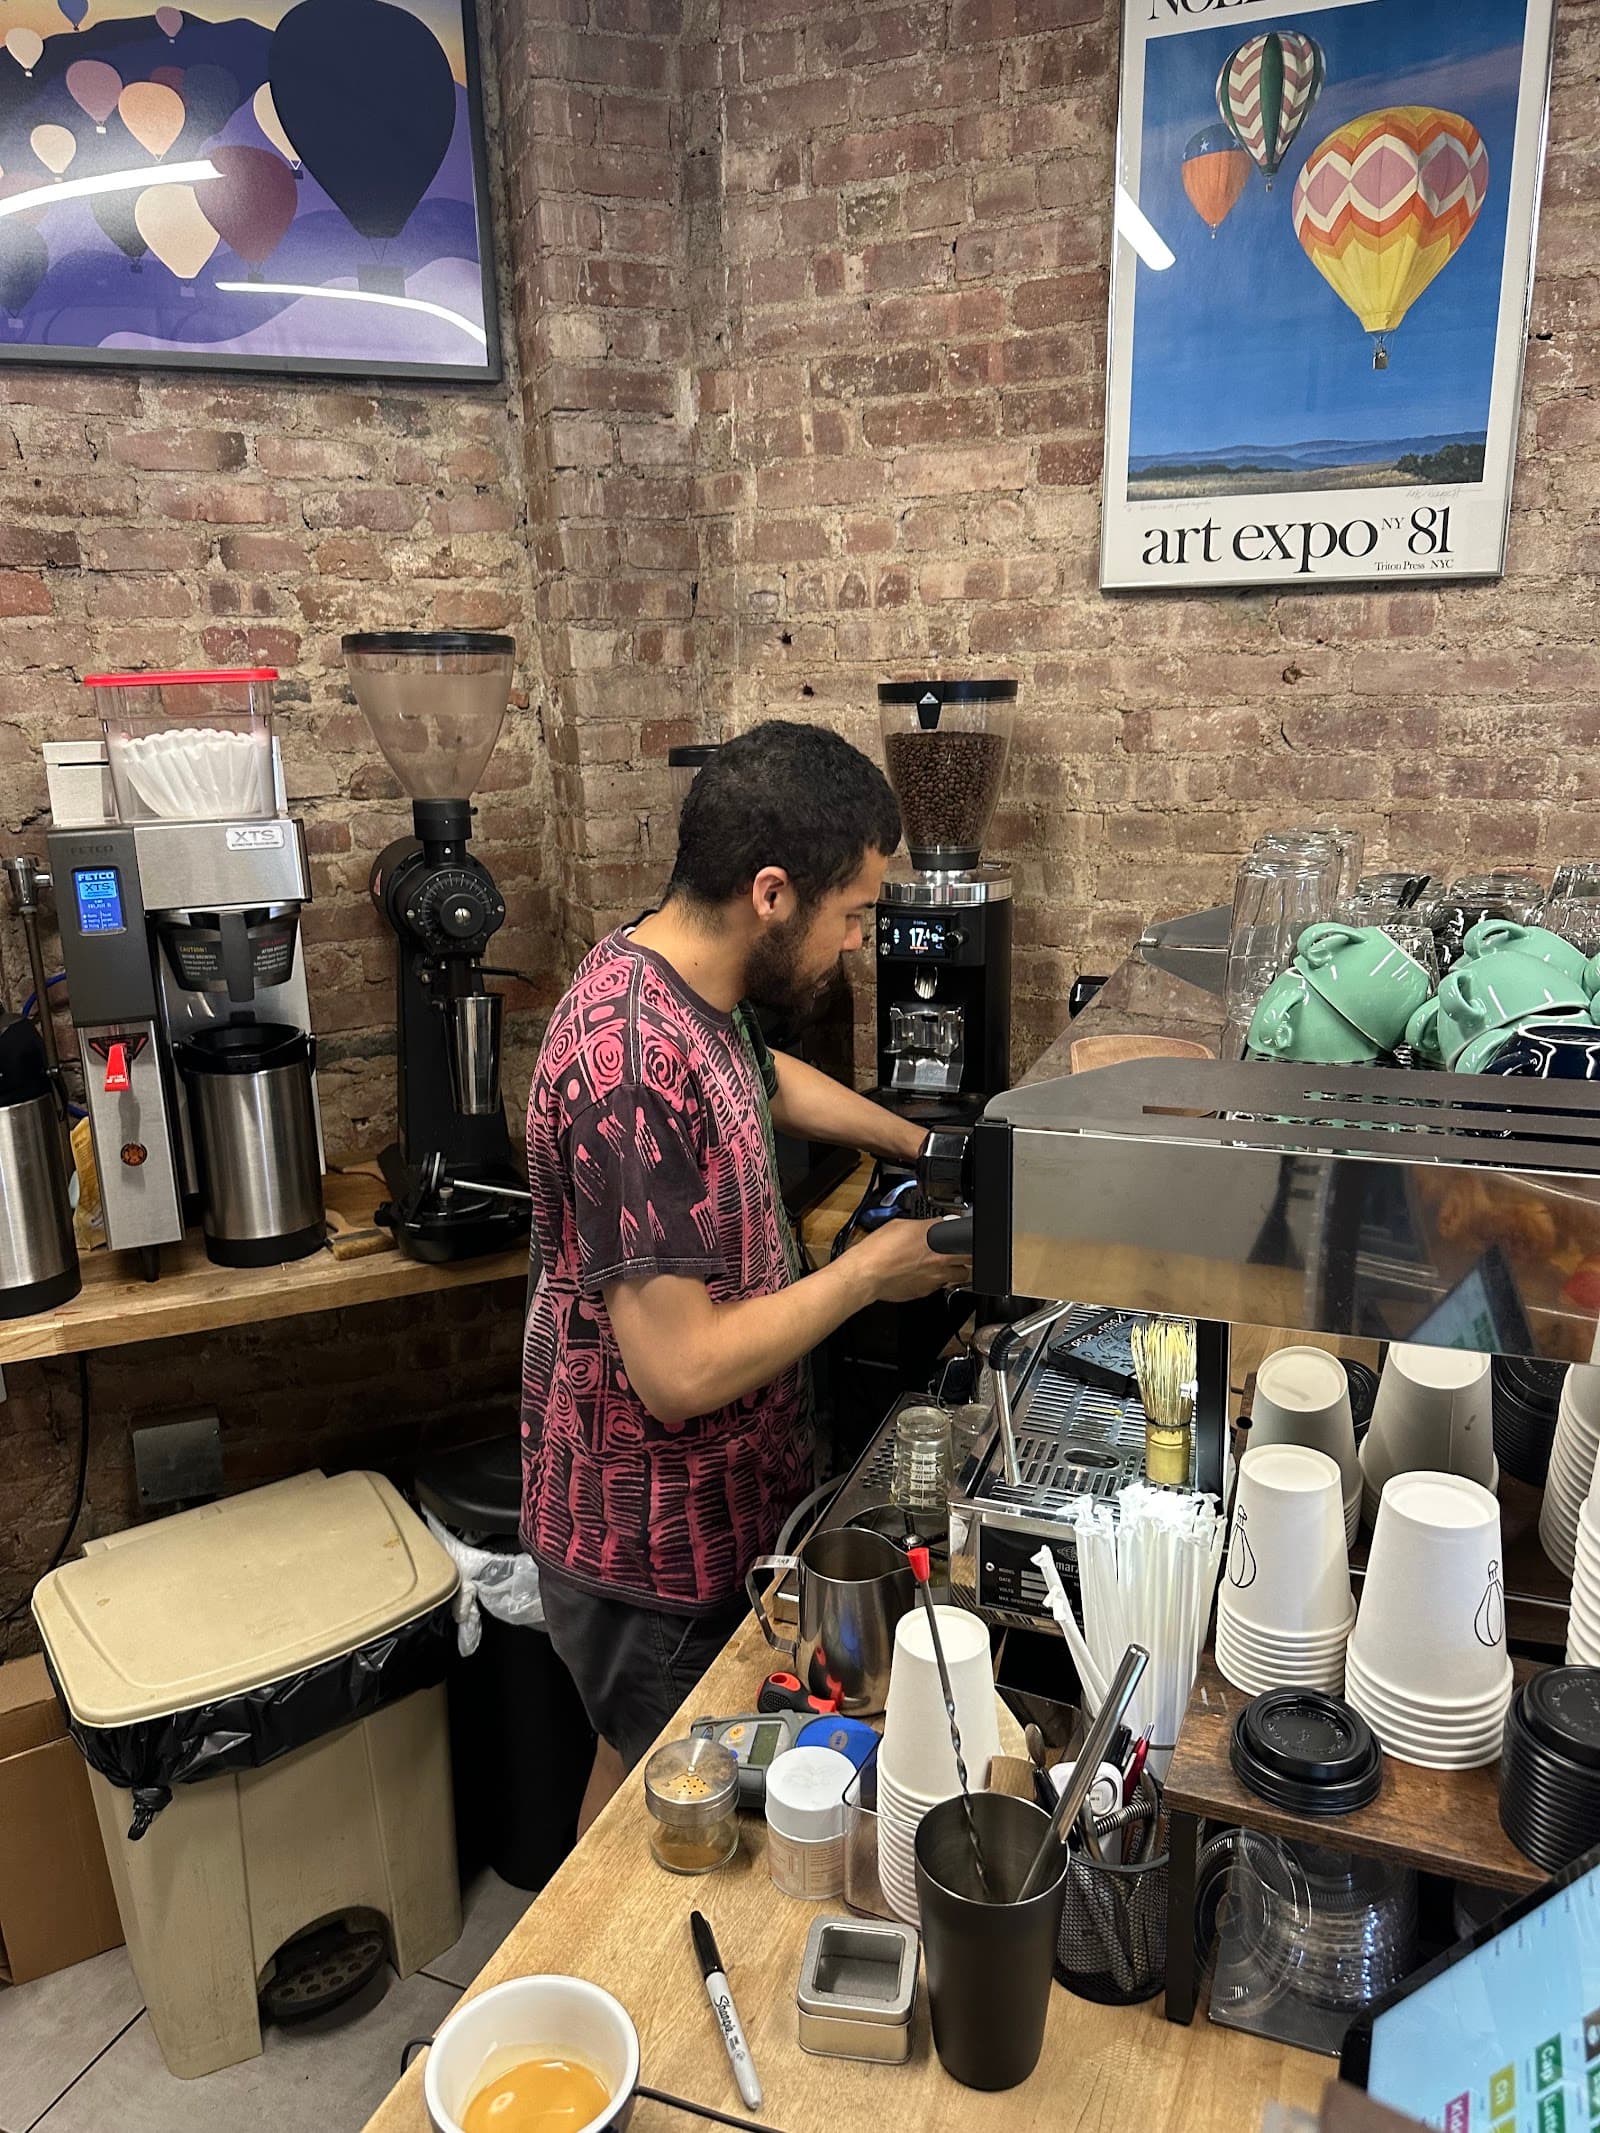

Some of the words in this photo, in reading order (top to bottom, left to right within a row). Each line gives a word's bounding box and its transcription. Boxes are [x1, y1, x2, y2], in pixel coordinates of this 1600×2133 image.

[1142, 517, 1222, 565] art
[1232, 519, 1379, 574] expo
[1381, 517, 1405, 530] NY
[1407, 506, 1455, 555] 81
[1374, 560, 1402, 571] Triton
[1403, 561, 1425, 570] Press
[1430, 559, 1454, 569] NYC
[235, 830, 275, 842] XTS
[78, 871, 115, 881] FETCO
[85, 883, 110, 892] XTS
